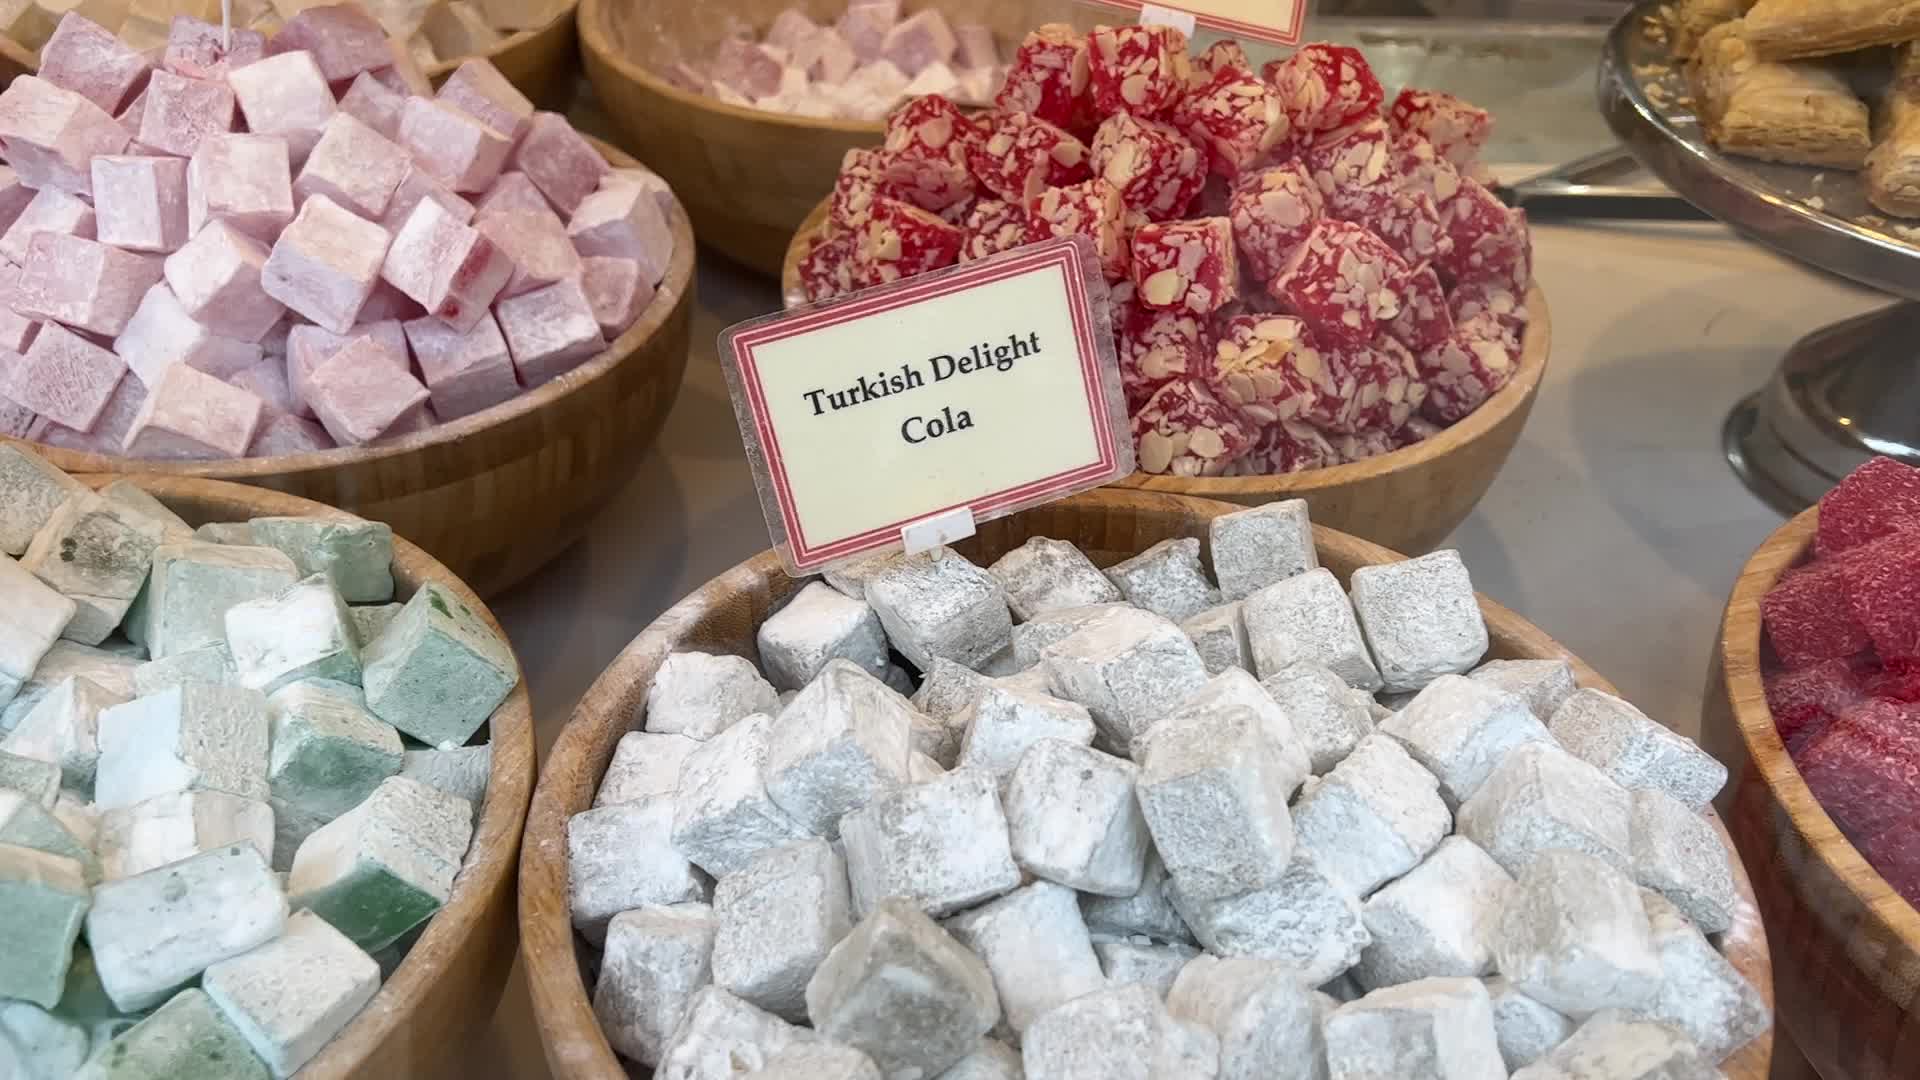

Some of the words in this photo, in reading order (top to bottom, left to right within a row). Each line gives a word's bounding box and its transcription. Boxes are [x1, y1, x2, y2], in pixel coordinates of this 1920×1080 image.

[803, 364, 925, 416] Turkish
[928, 331, 1041, 382] Delight
[901, 406, 975, 444] Cola
